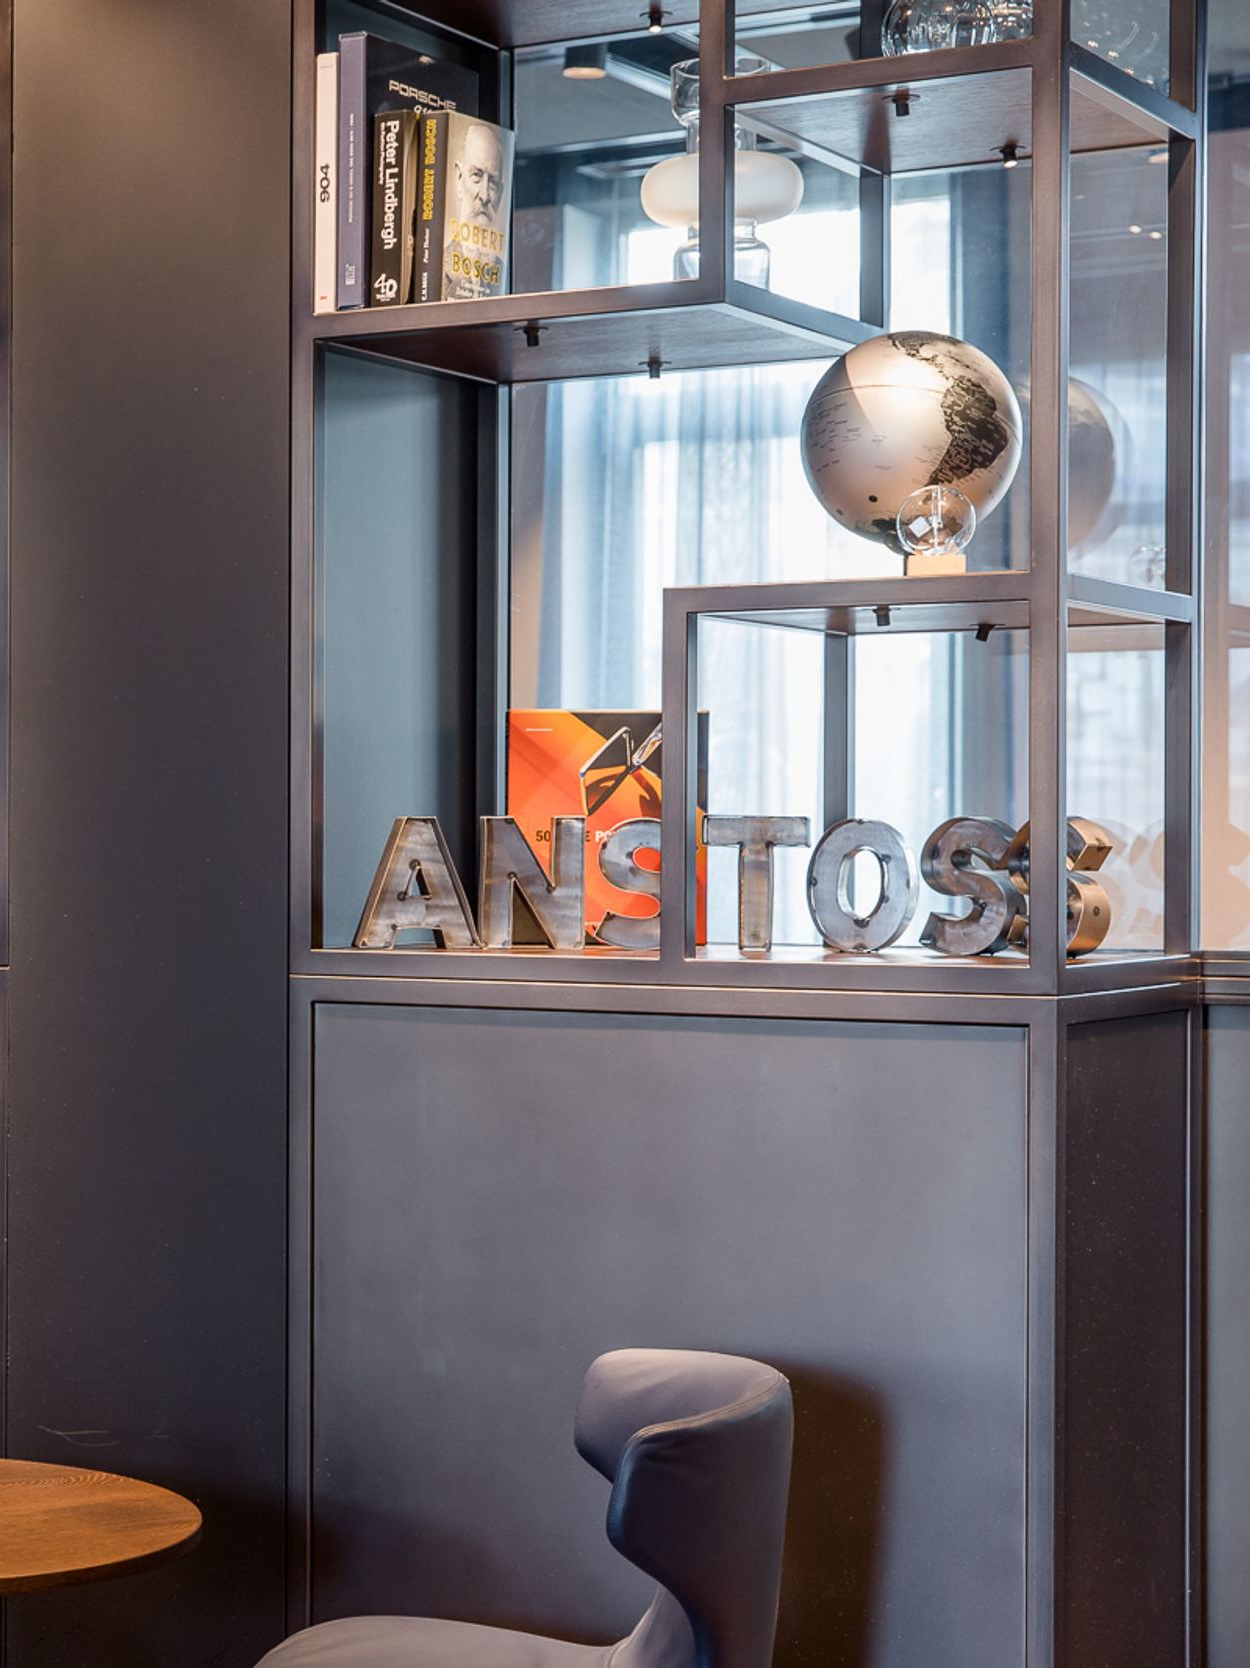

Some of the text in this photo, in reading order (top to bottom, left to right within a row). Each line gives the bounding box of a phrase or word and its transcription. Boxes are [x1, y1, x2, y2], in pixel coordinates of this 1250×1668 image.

[388, 79, 457, 110] PORSCHE
[424, 119, 437, 165] BOSCH
[320, 164, 330, 203] 904
[381, 120, 400, 250] Peter Lindbergh
[451, 218, 505, 252] ROBERT
[451, 251, 502, 285] BOSCH
